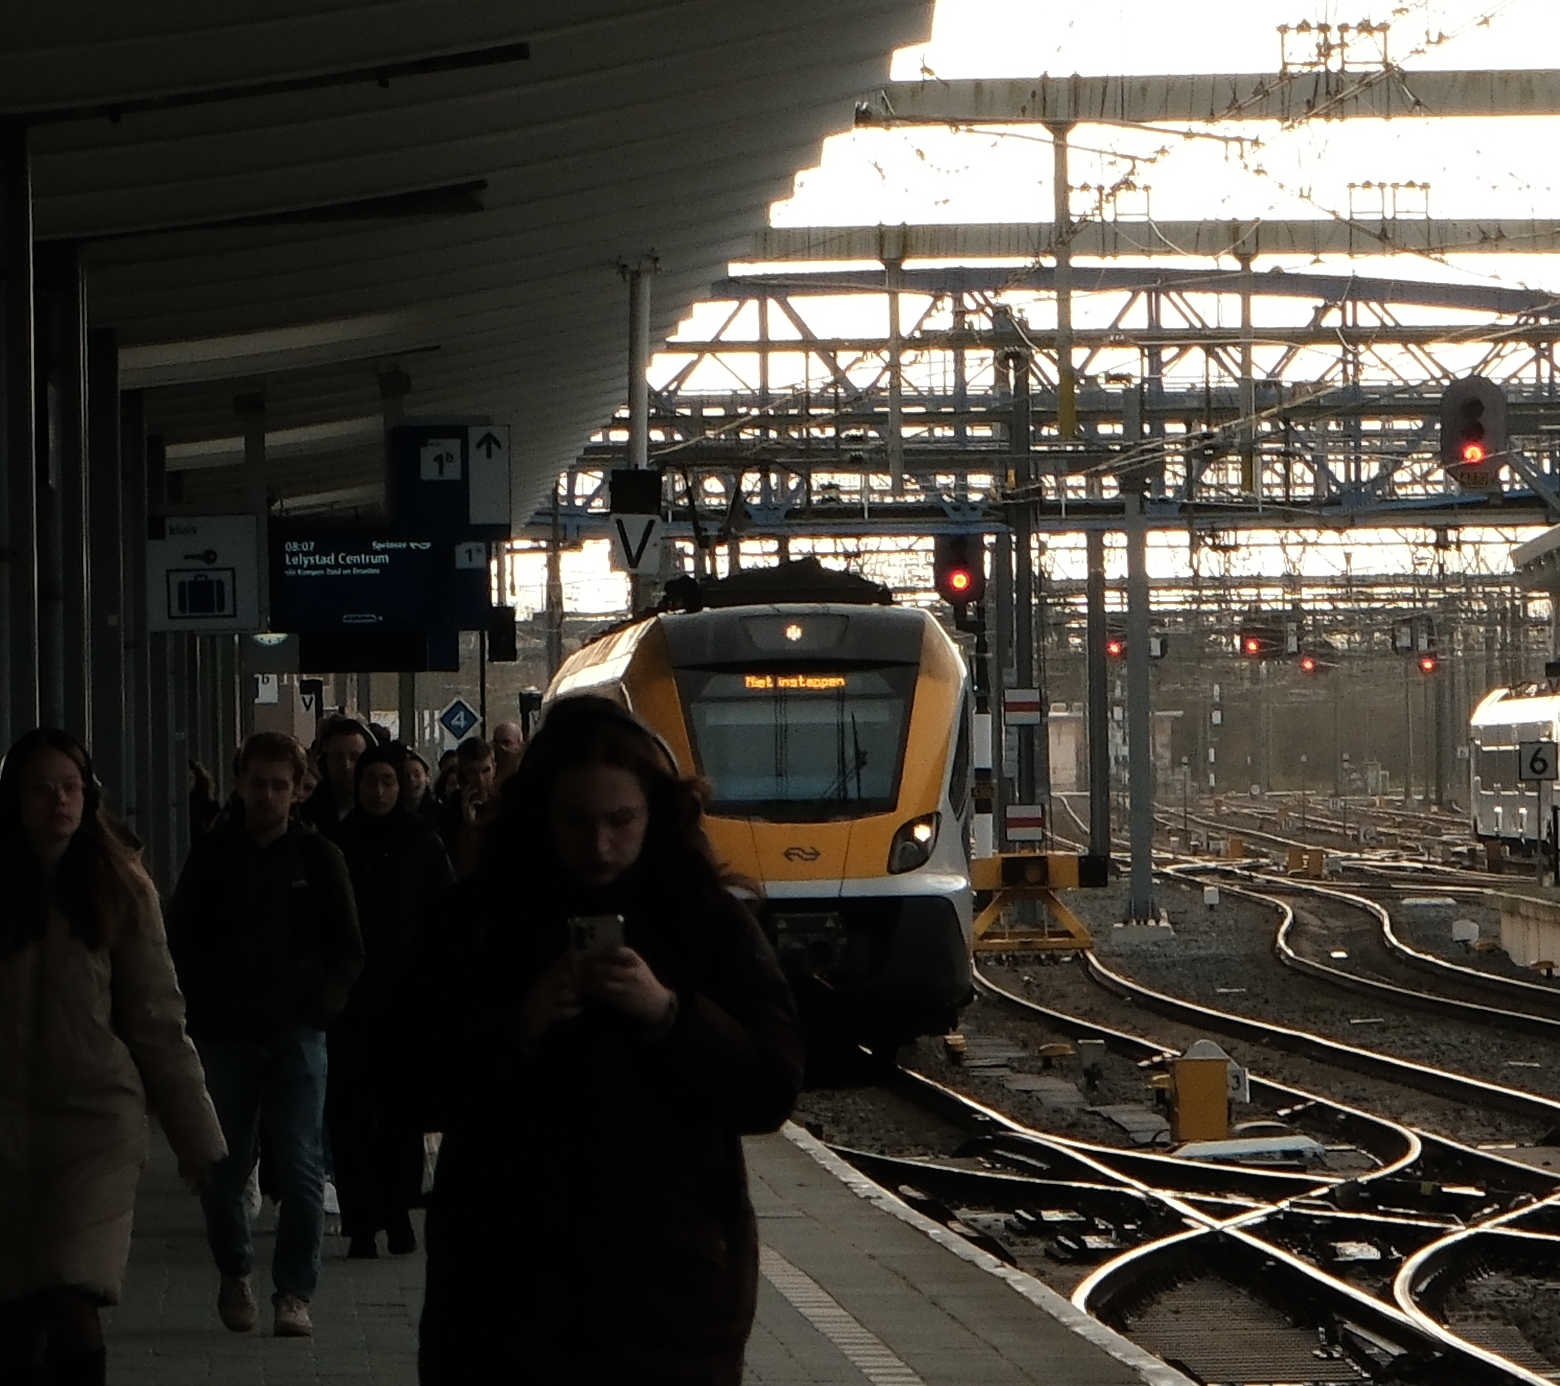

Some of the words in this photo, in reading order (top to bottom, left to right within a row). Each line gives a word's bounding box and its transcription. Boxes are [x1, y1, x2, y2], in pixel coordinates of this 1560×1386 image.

[616, 518, 655, 569] V
[284, 553, 334, 568] Lelystad
[338, 553, 390, 565] Centrum
[450, 712, 468, 729] 4
[1529, 746, 1549, 775] 6
